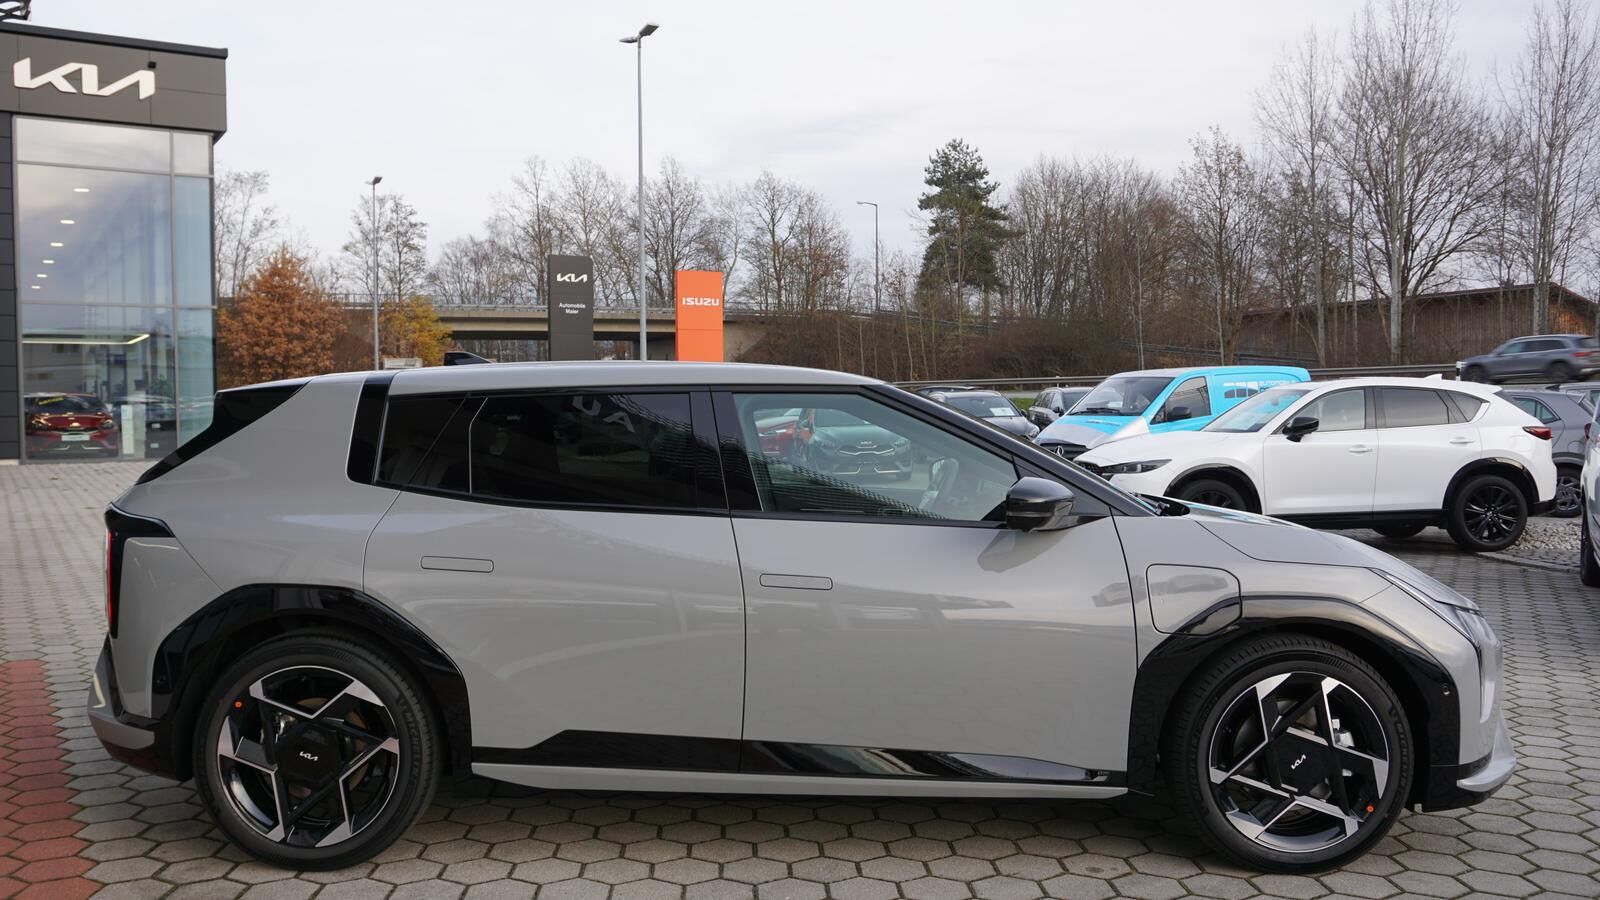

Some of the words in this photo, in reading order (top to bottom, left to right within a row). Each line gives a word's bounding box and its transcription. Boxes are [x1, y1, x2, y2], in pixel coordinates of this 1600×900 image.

[13, 57, 156, 100] KIA
[556, 273, 588, 283] KIA
[682, 297, 720, 306] ISUZU
